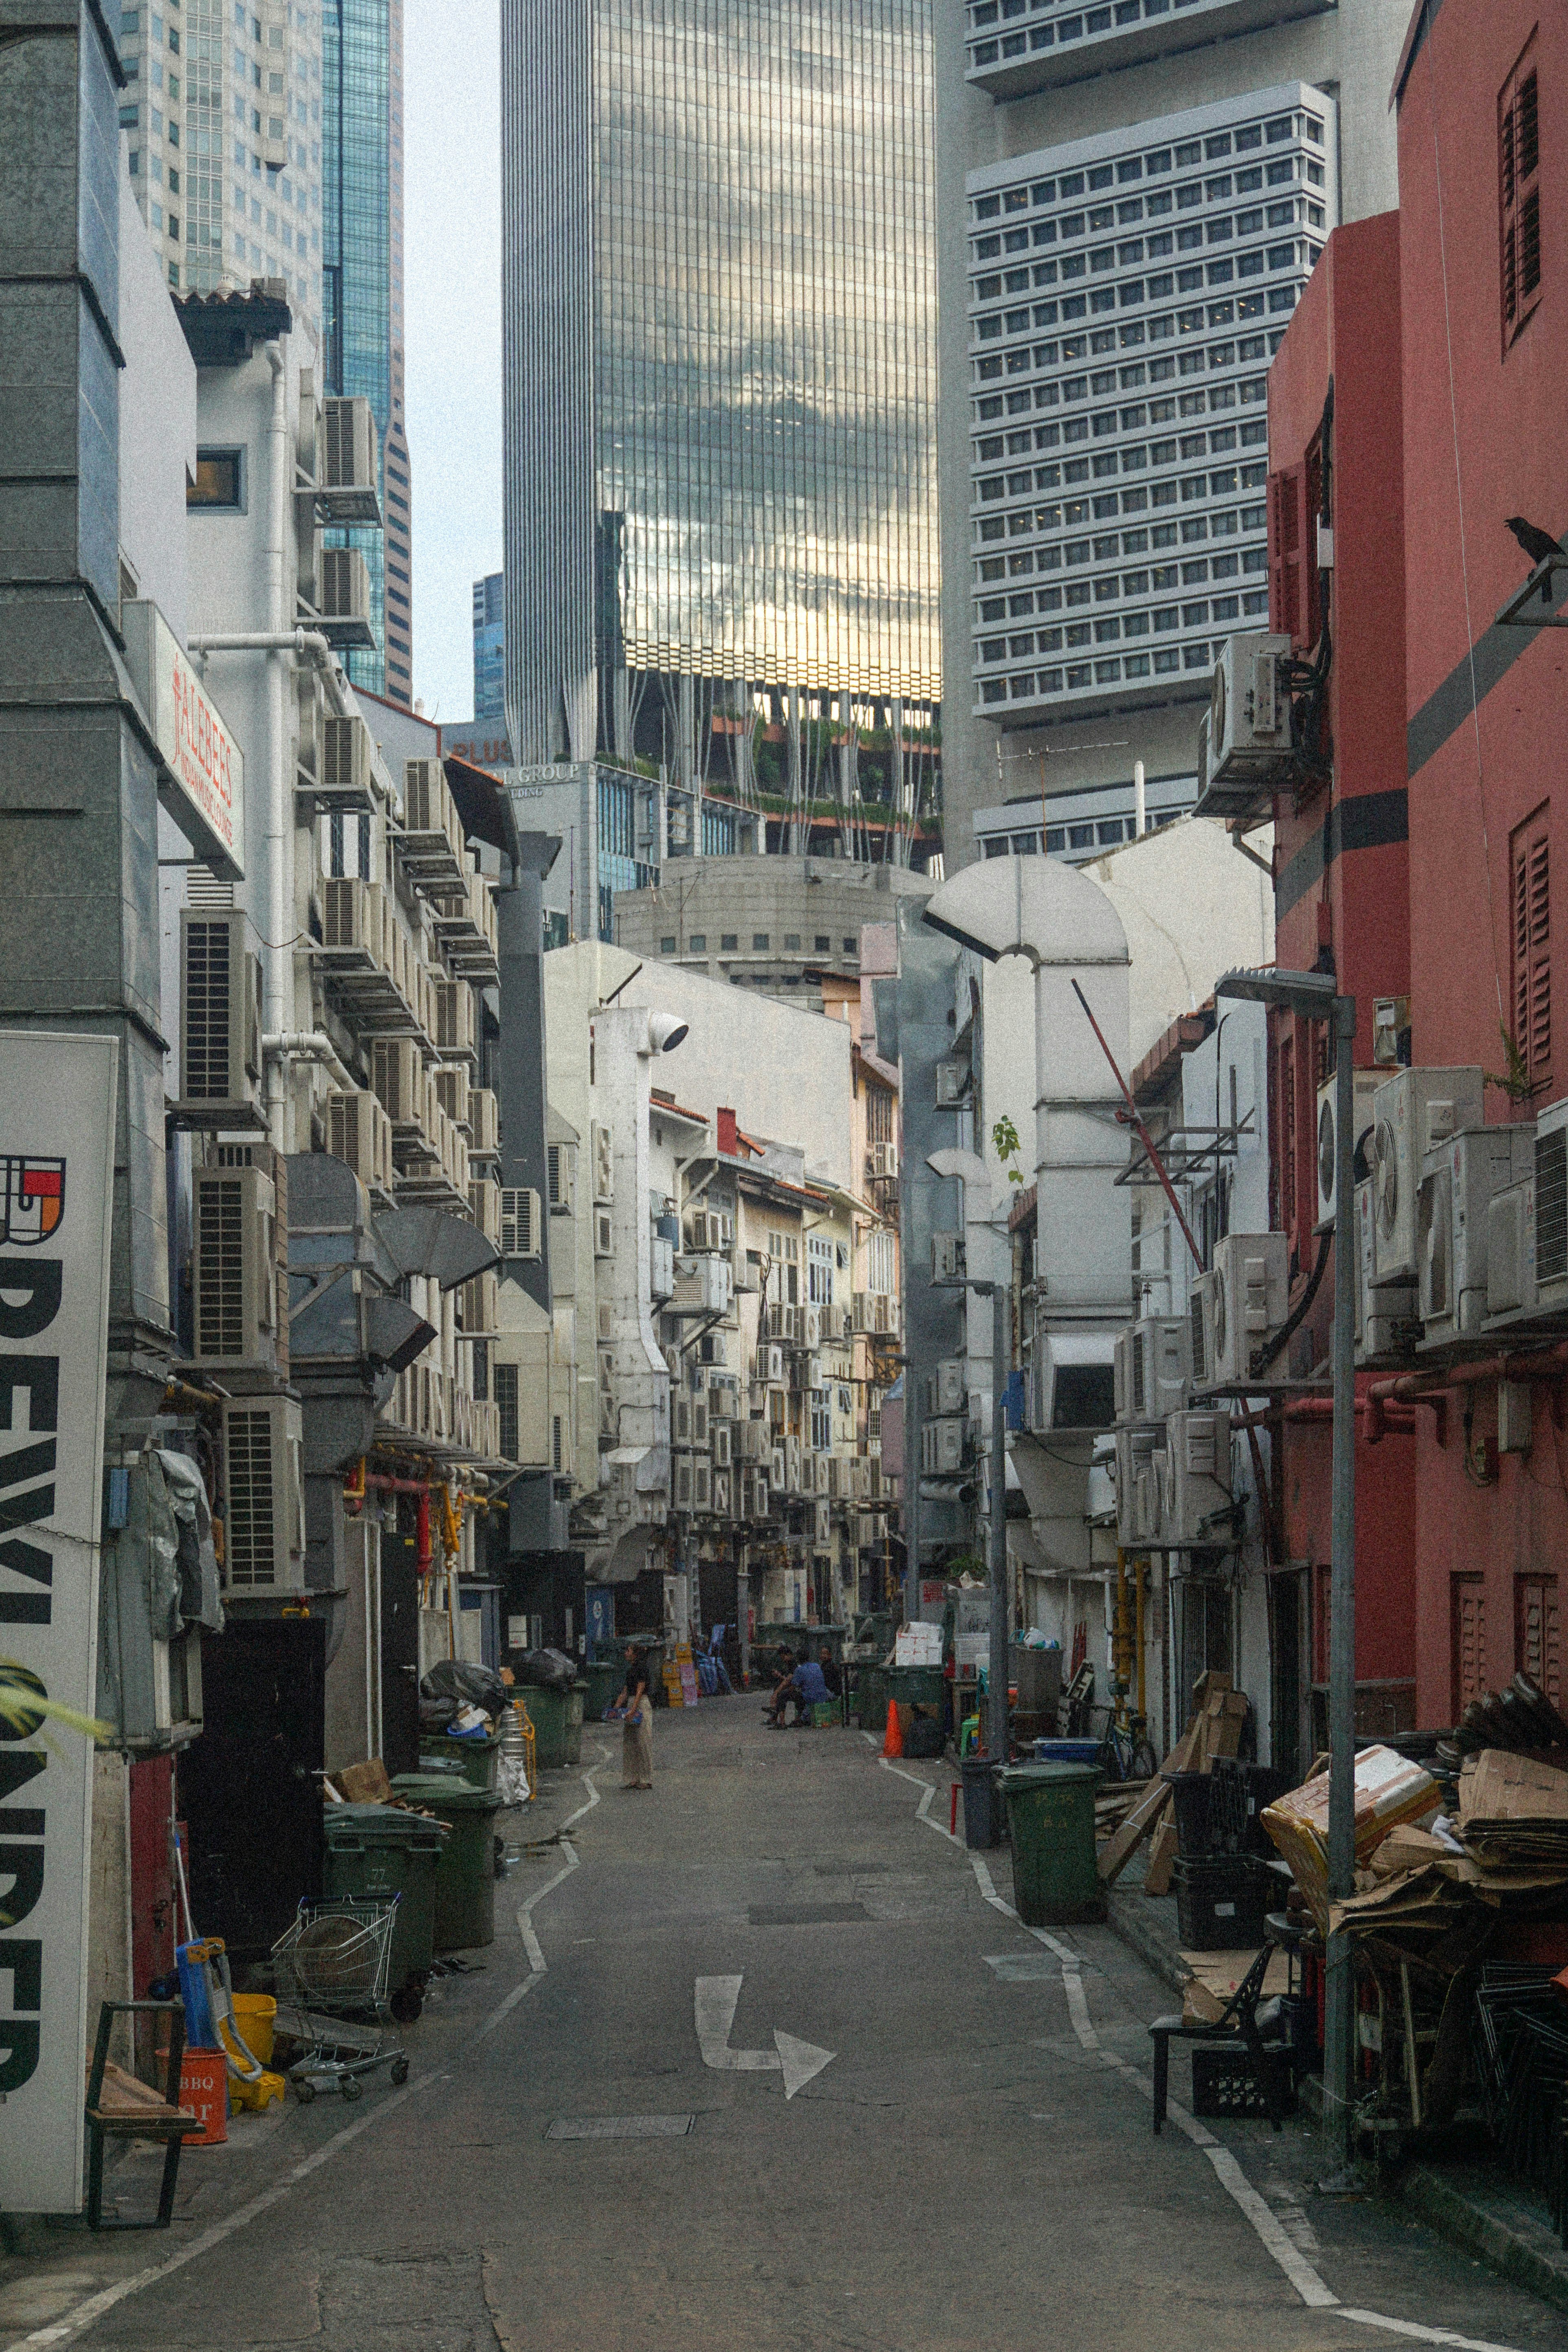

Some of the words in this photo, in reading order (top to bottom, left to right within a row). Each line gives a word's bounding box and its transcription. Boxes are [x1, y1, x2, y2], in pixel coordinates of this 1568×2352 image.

[453, 739, 510, 765] PLUS
[518, 764, 579, 783] GROUP
[182, 749, 198, 795] INDIAN
[198, 776, 213, 820] MUSIC
[215, 800, 232, 847] LOUNGE
[180, 2077, 213, 2091] BBQ
